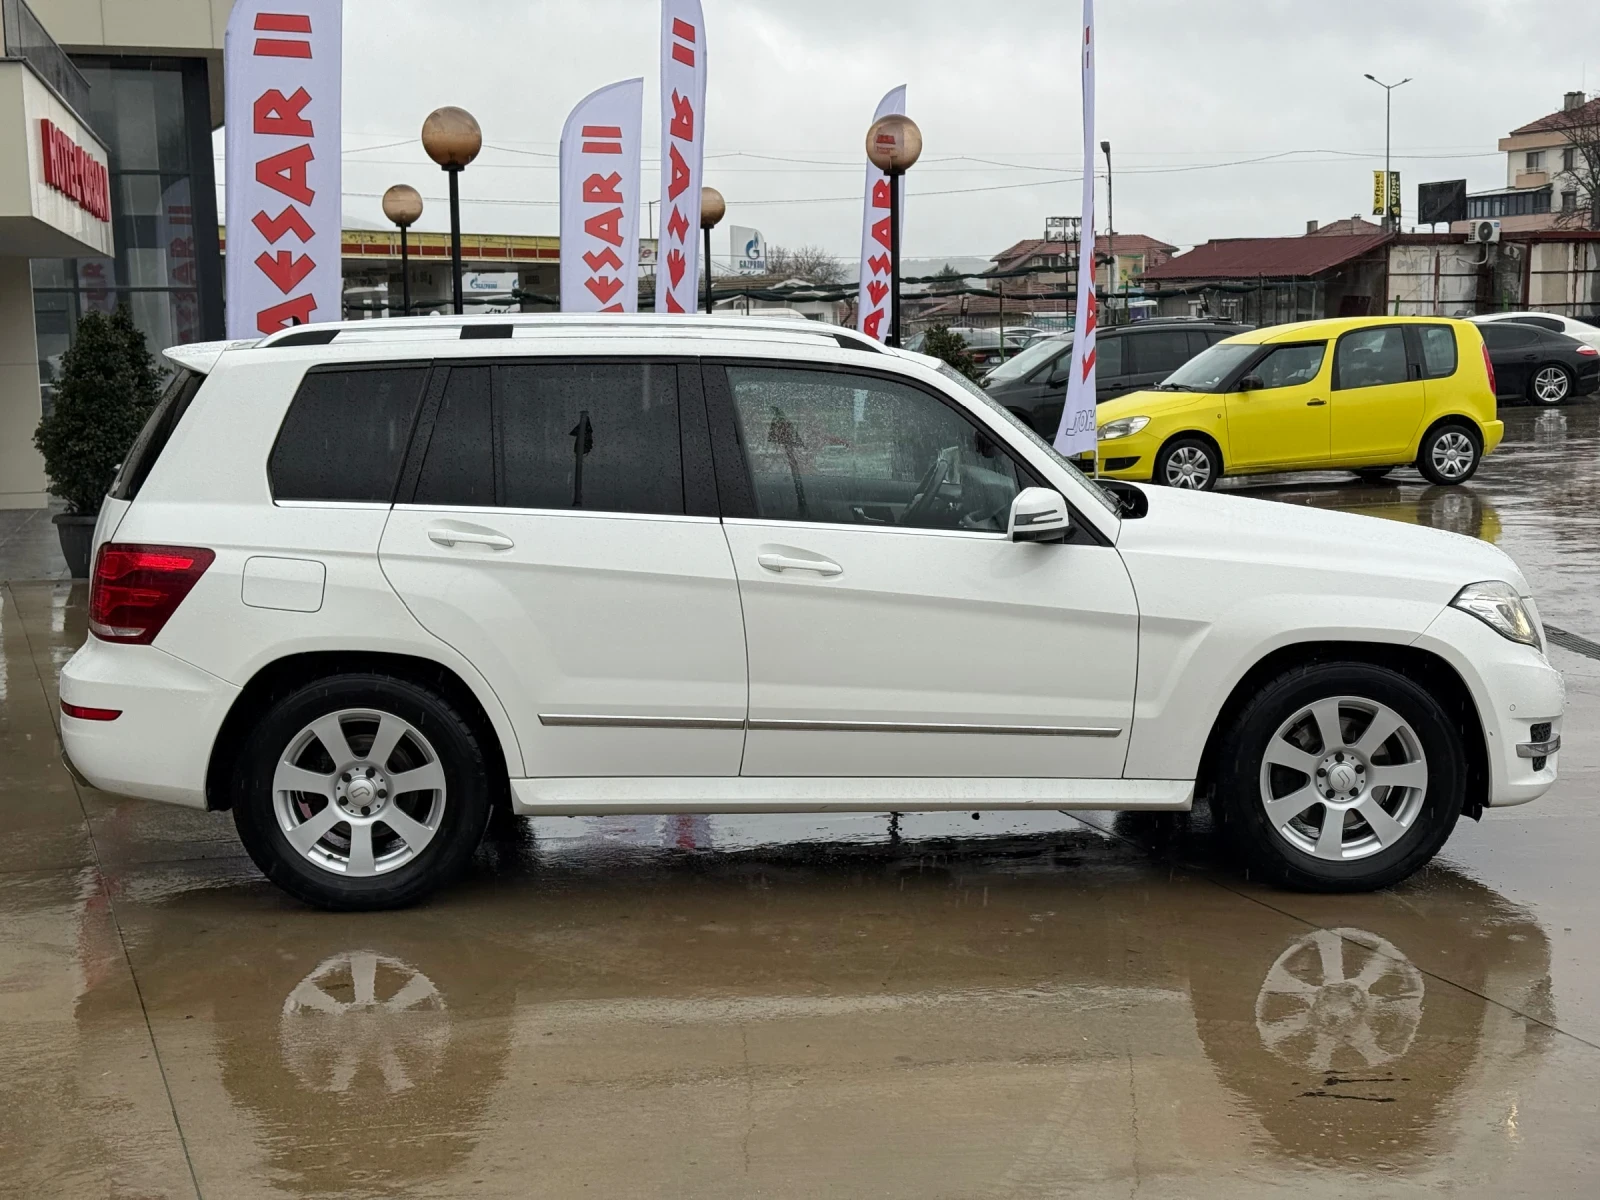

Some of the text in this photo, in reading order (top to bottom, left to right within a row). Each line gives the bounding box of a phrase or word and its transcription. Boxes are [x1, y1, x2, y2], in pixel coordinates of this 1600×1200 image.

[253, 13, 313, 59] II
[581, 126, 623, 155] II
[41, 119, 82, 202] HOTEL
[739, 260, 765, 269] GAZPROM
